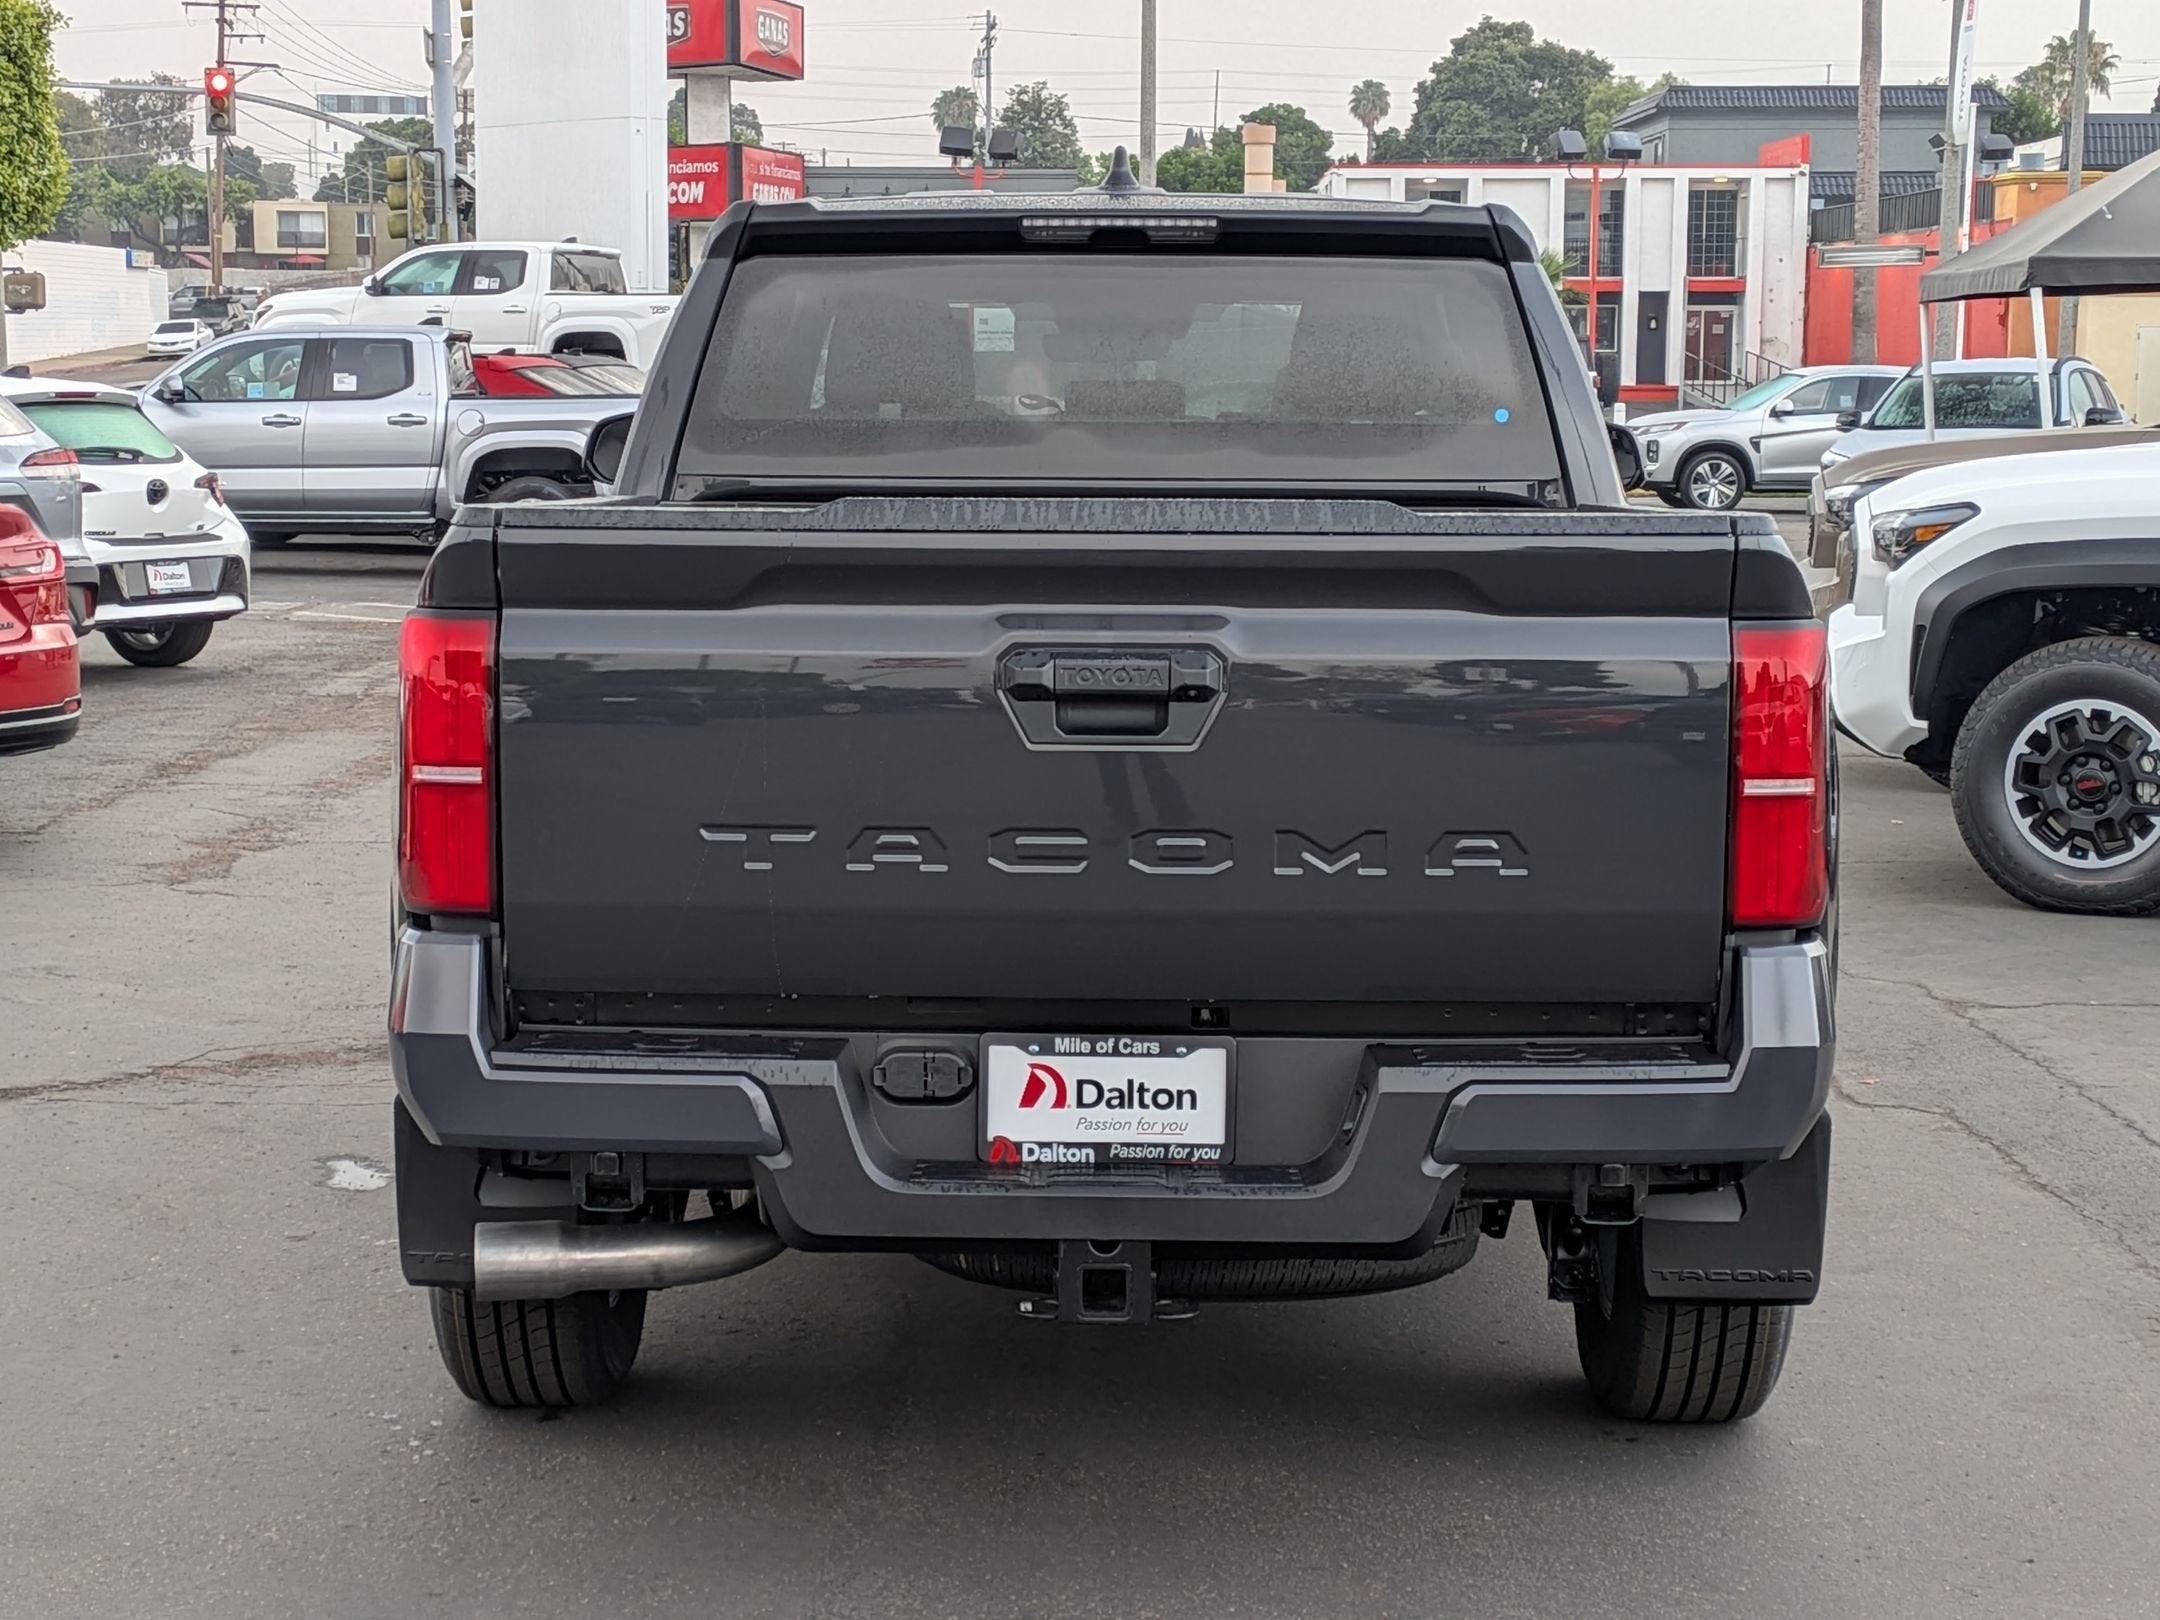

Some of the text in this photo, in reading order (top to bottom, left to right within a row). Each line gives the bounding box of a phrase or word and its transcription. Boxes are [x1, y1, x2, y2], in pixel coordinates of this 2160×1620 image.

[1958, 55, 1969, 122] TOYOTA
[669, 158, 719, 174] nciamos
[162, 572, 186, 581] Dalton
[1061, 666, 1164, 687] TOYOTA
[699, 824, 1530, 875] TACOMA
[1054, 1037, 1160, 1054] Mile of Cars
[1076, 1078, 1198, 1110] Dalton
[1075, 1116, 1189, 1133] Passion for you
[1021, 1143, 1221, 1164] Dalton Passion for you
[1651, 1267, 1814, 1284] TACOMA
